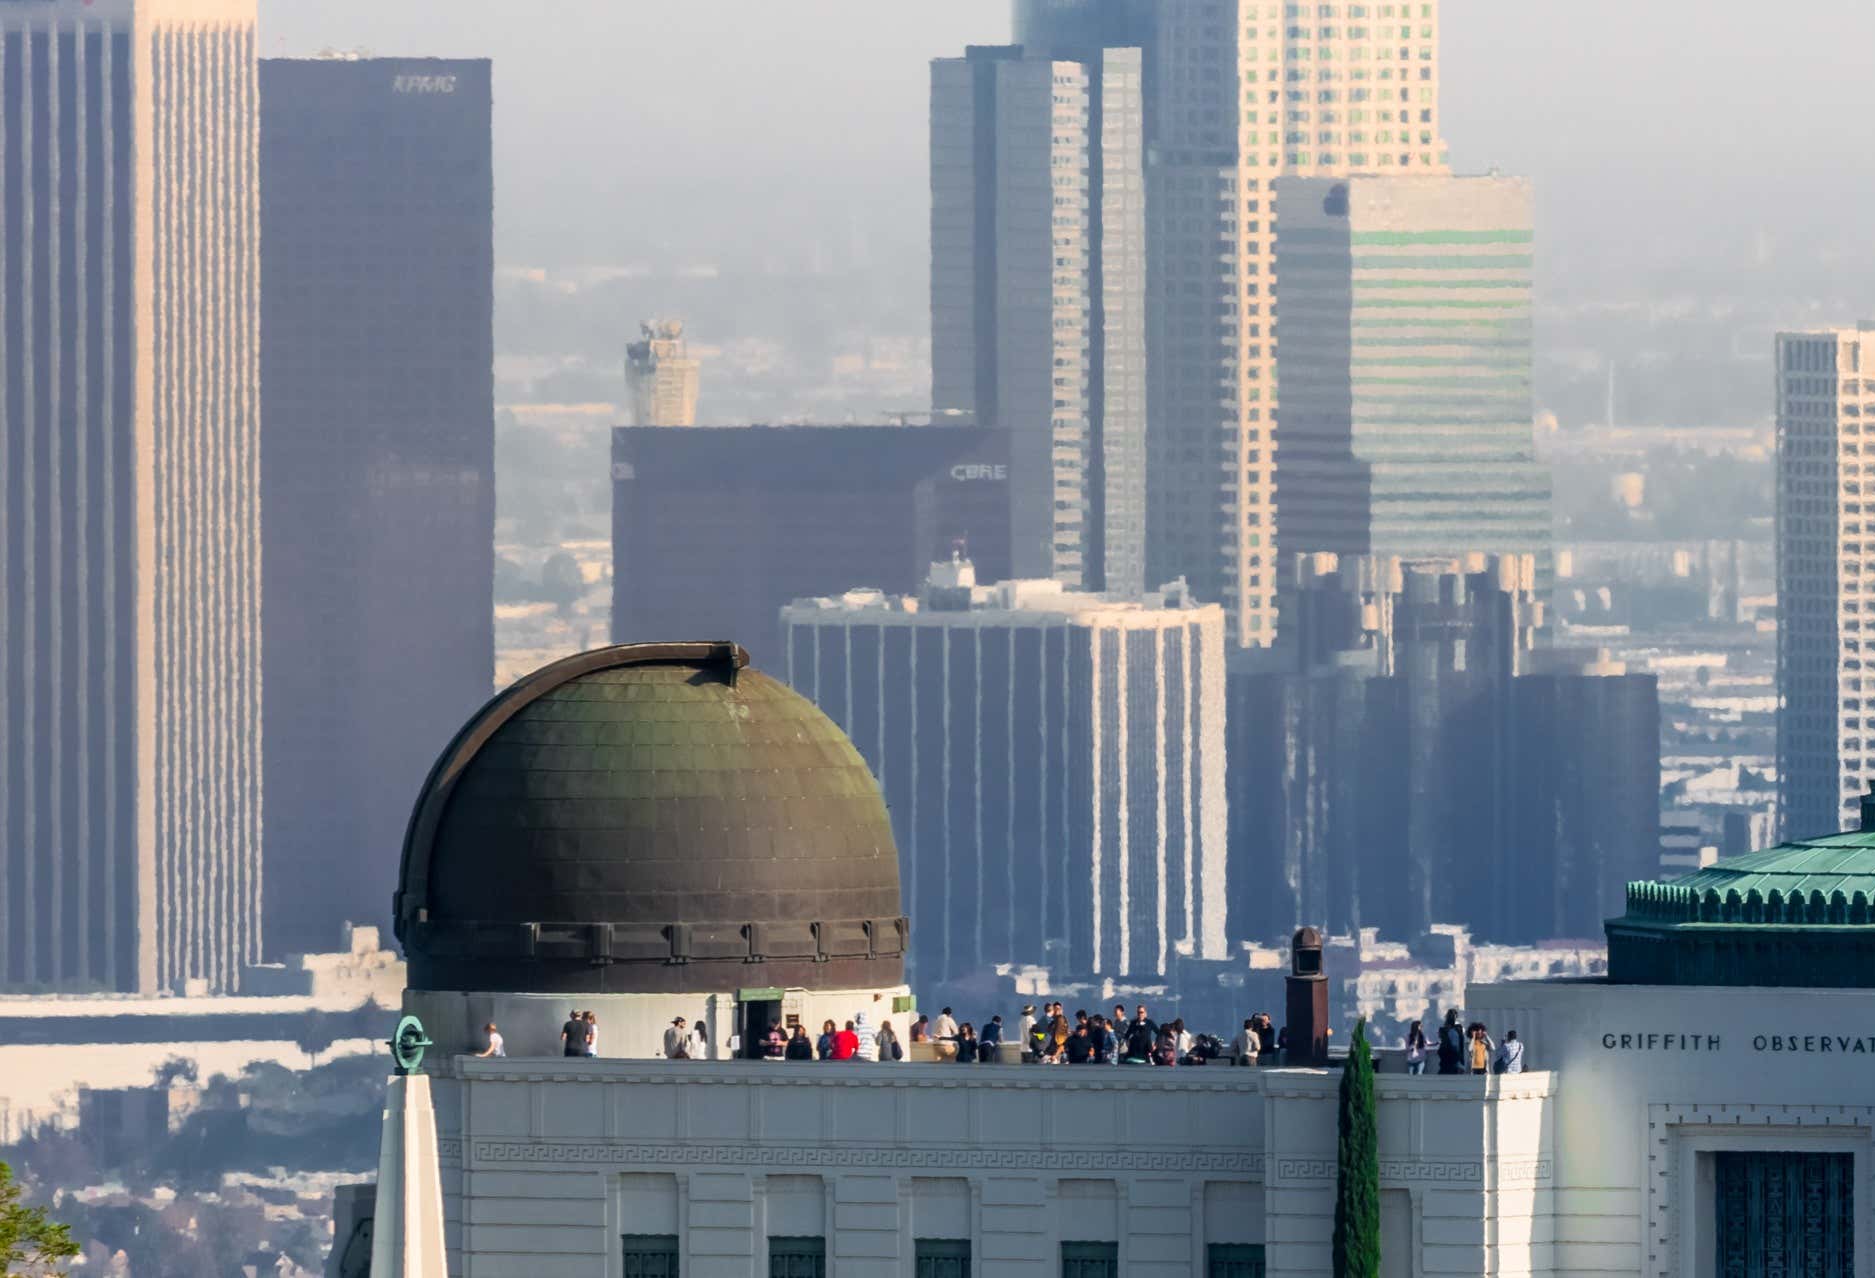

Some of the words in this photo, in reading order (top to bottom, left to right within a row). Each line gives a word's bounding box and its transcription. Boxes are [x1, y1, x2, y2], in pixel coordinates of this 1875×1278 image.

[393, 75, 456, 94] KPMG
[950, 464, 1008, 481] CBRE
[1602, 1033, 1721, 1051] GRIFFITH
